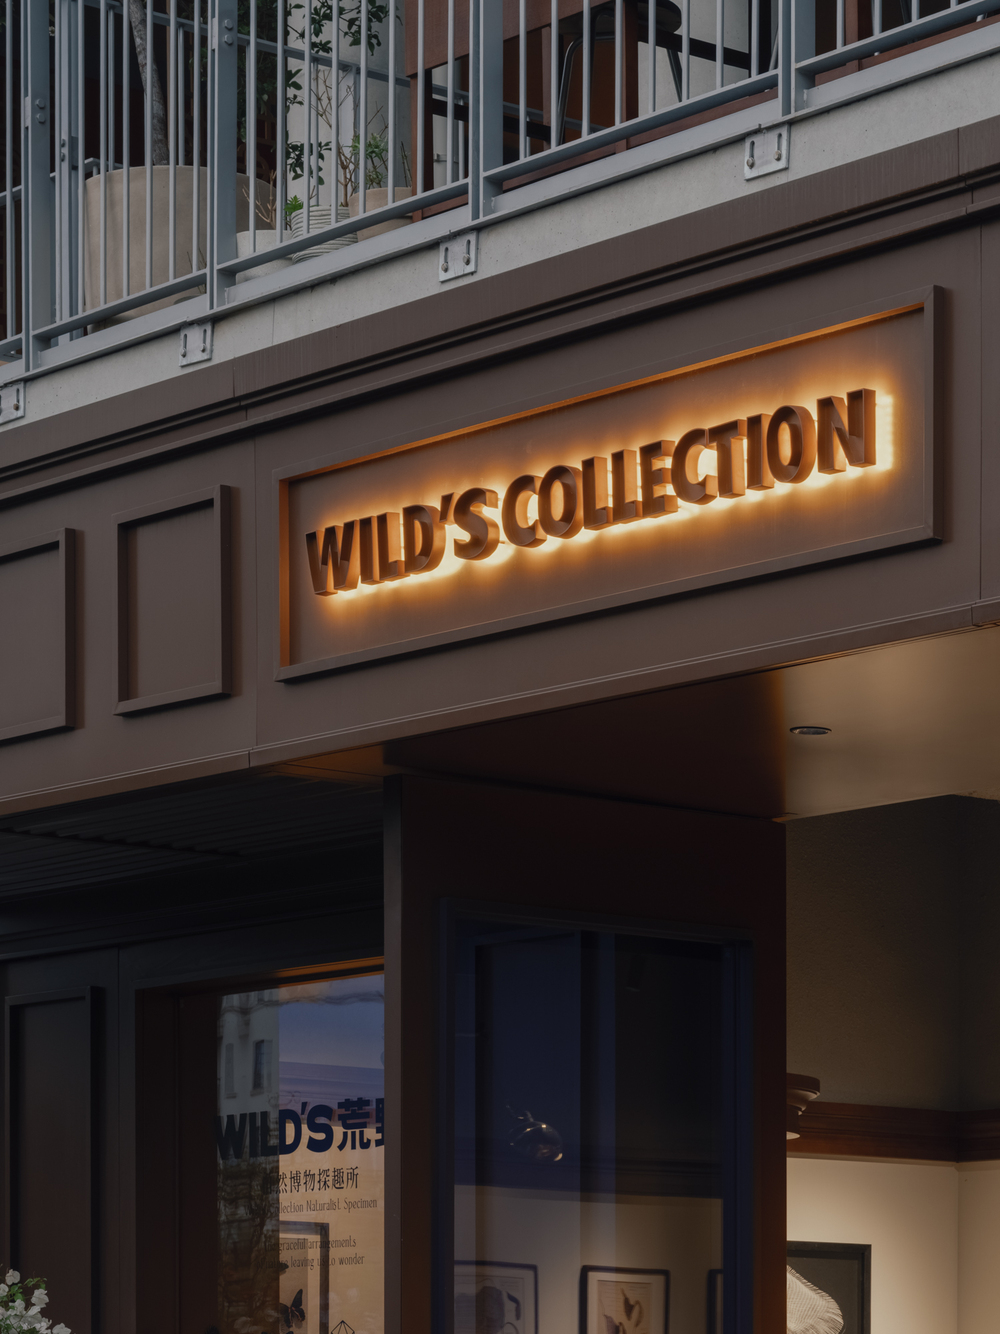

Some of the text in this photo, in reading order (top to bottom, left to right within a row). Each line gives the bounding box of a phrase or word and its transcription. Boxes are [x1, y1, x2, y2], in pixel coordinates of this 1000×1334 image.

[305, 388, 877, 597] WILD'S COLLECTION
[306, 1197, 341, 1211] Naturalist
[343, 1197, 378, 1214] Specimen
[308, 1234, 357, 1251] arrangements
[290, 1255, 314, 1271] leaving
[338, 1253, 365, 1266] wonder
